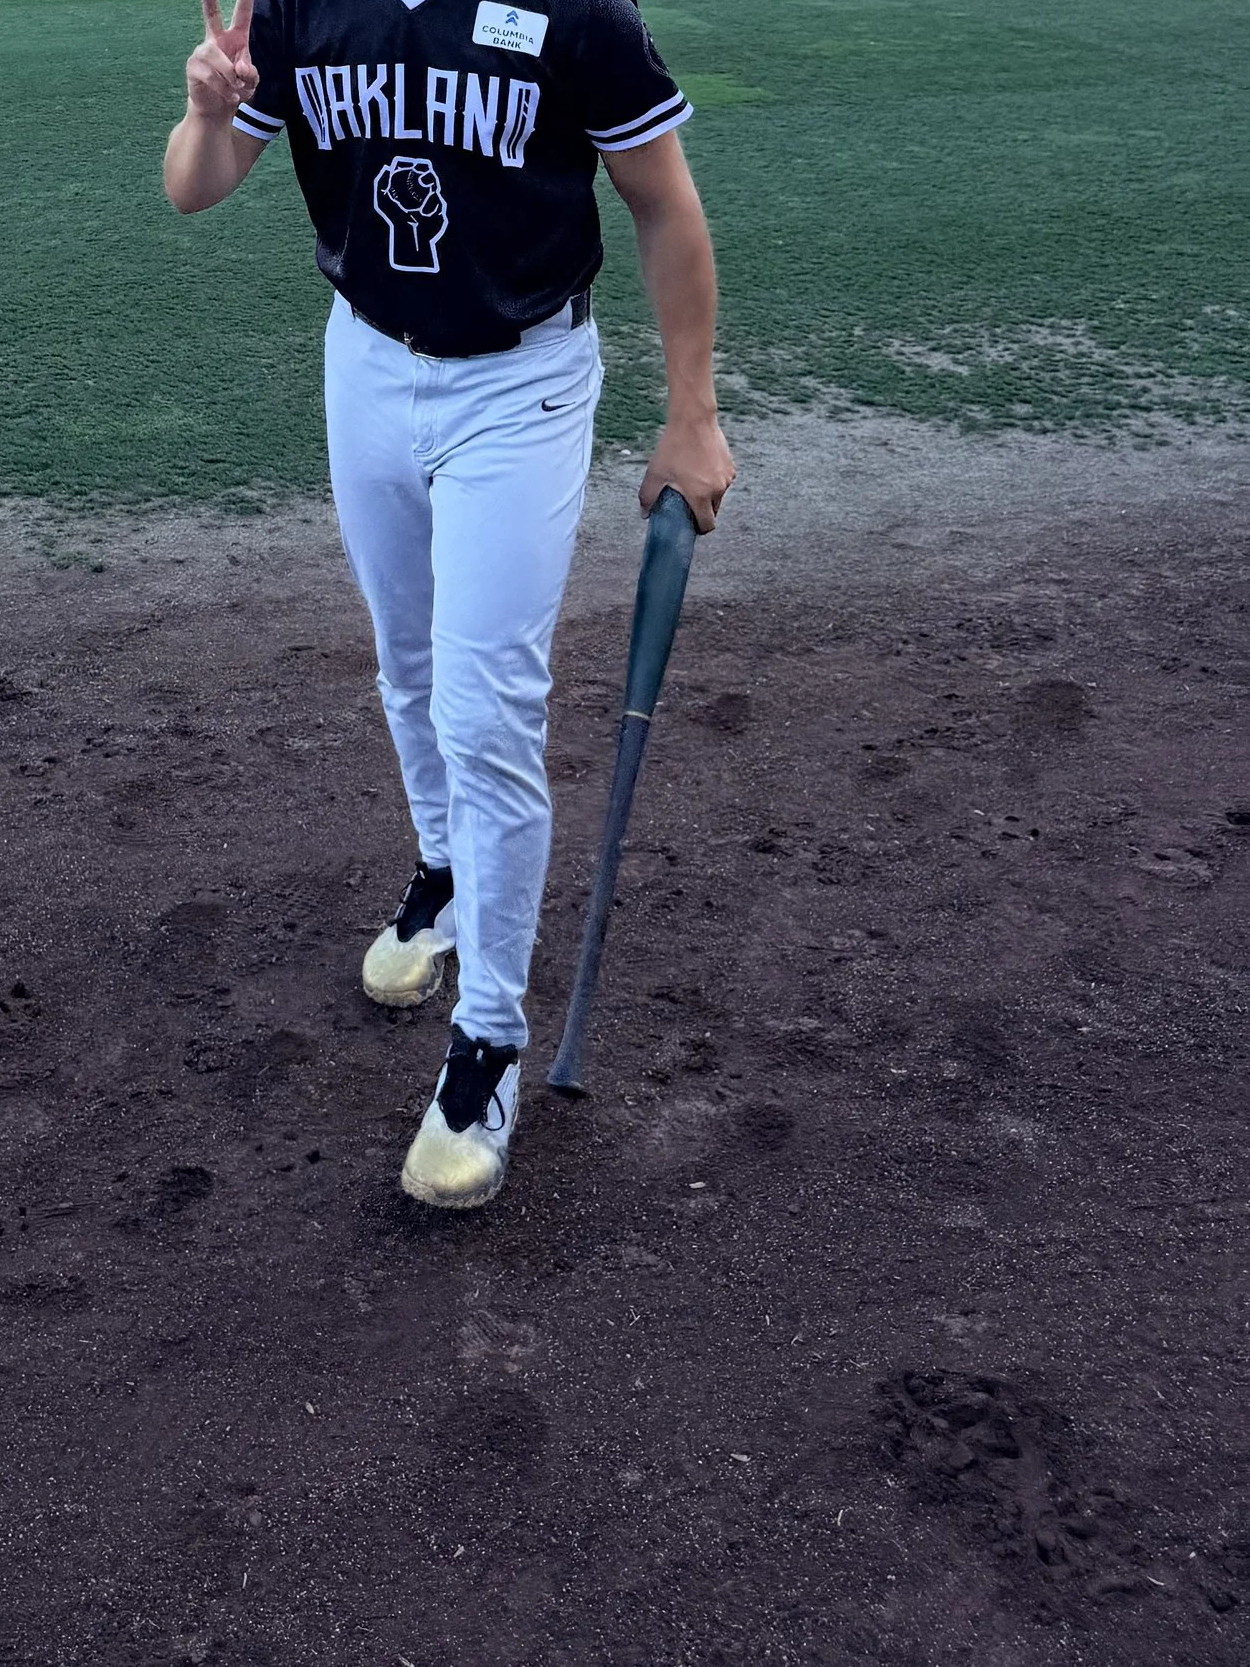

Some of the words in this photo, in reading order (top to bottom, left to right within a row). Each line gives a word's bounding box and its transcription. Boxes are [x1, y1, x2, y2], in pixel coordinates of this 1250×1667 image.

[482, 25, 534, 45] COLUMBIA
[492, 37, 522, 49] BANK
[295, 63, 540, 168] OAKLAND
